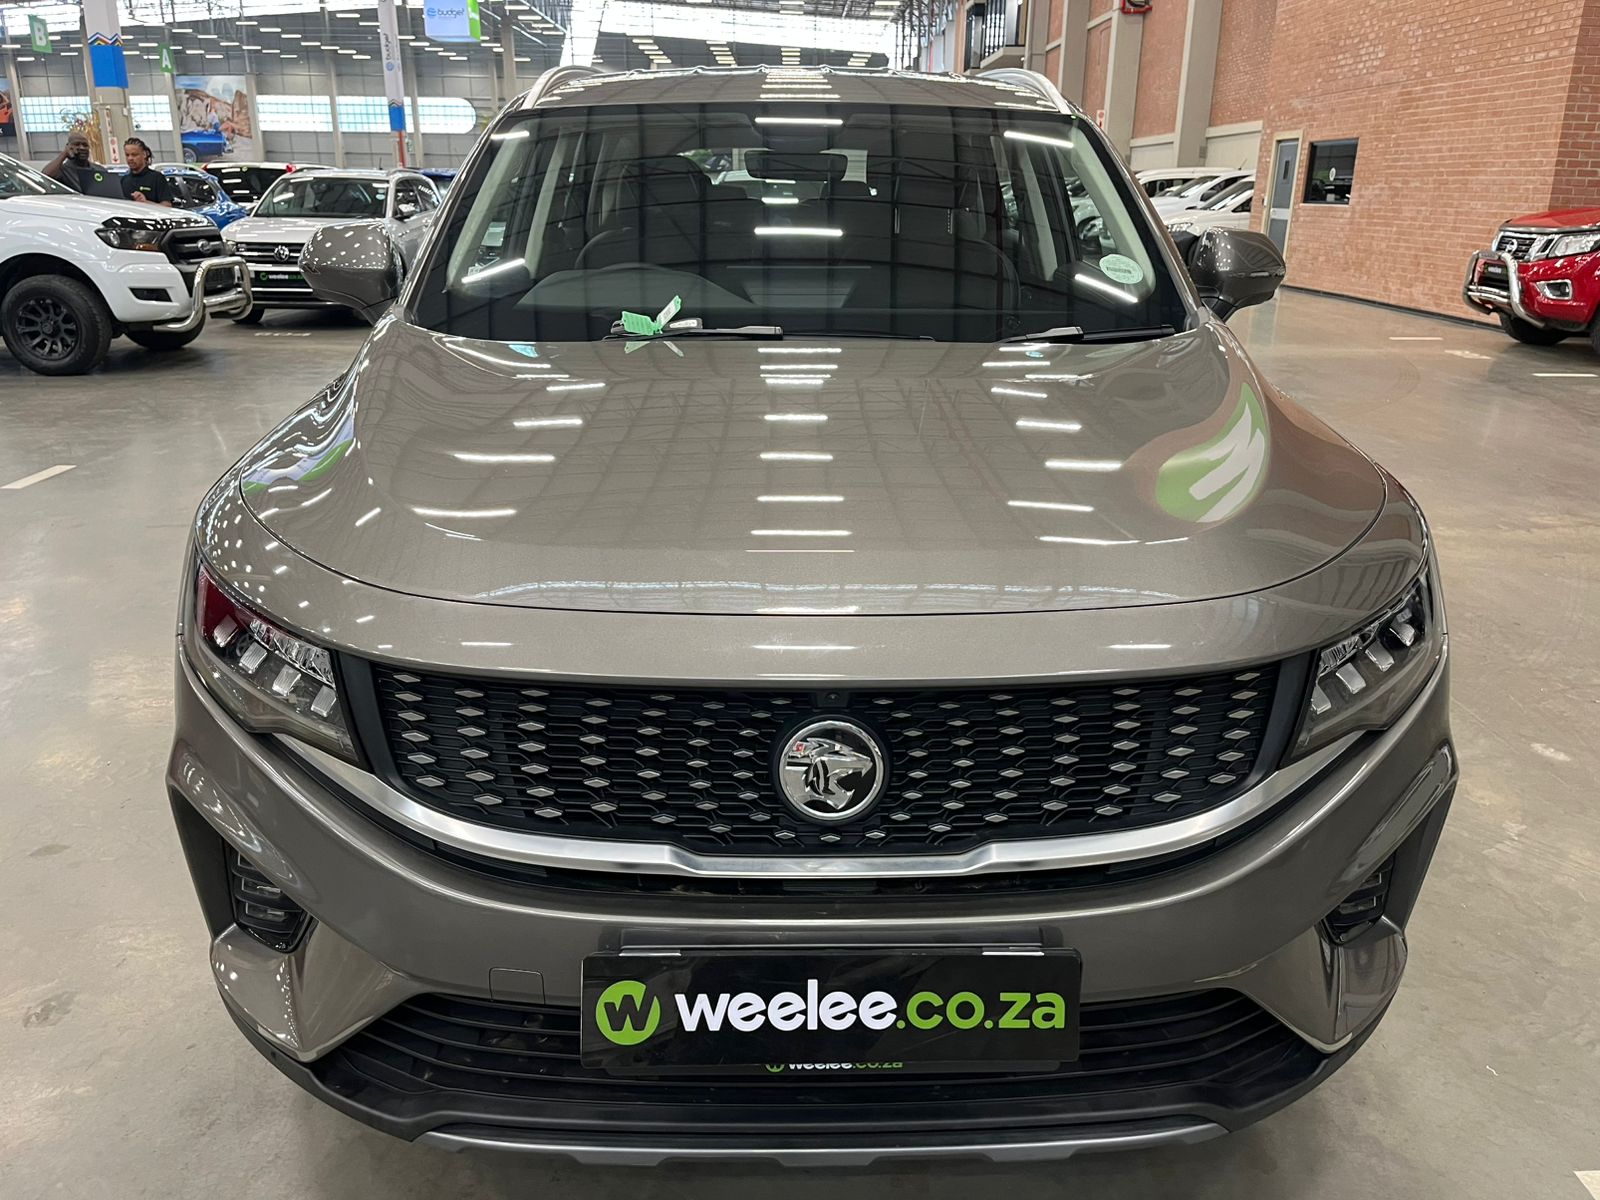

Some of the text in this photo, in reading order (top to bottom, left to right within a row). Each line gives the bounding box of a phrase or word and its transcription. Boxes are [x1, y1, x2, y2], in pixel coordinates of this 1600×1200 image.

[34, 22, 47, 47] B
[162, 48, 172, 69] A
[674, 979, 1065, 1032] weelee.co.za
